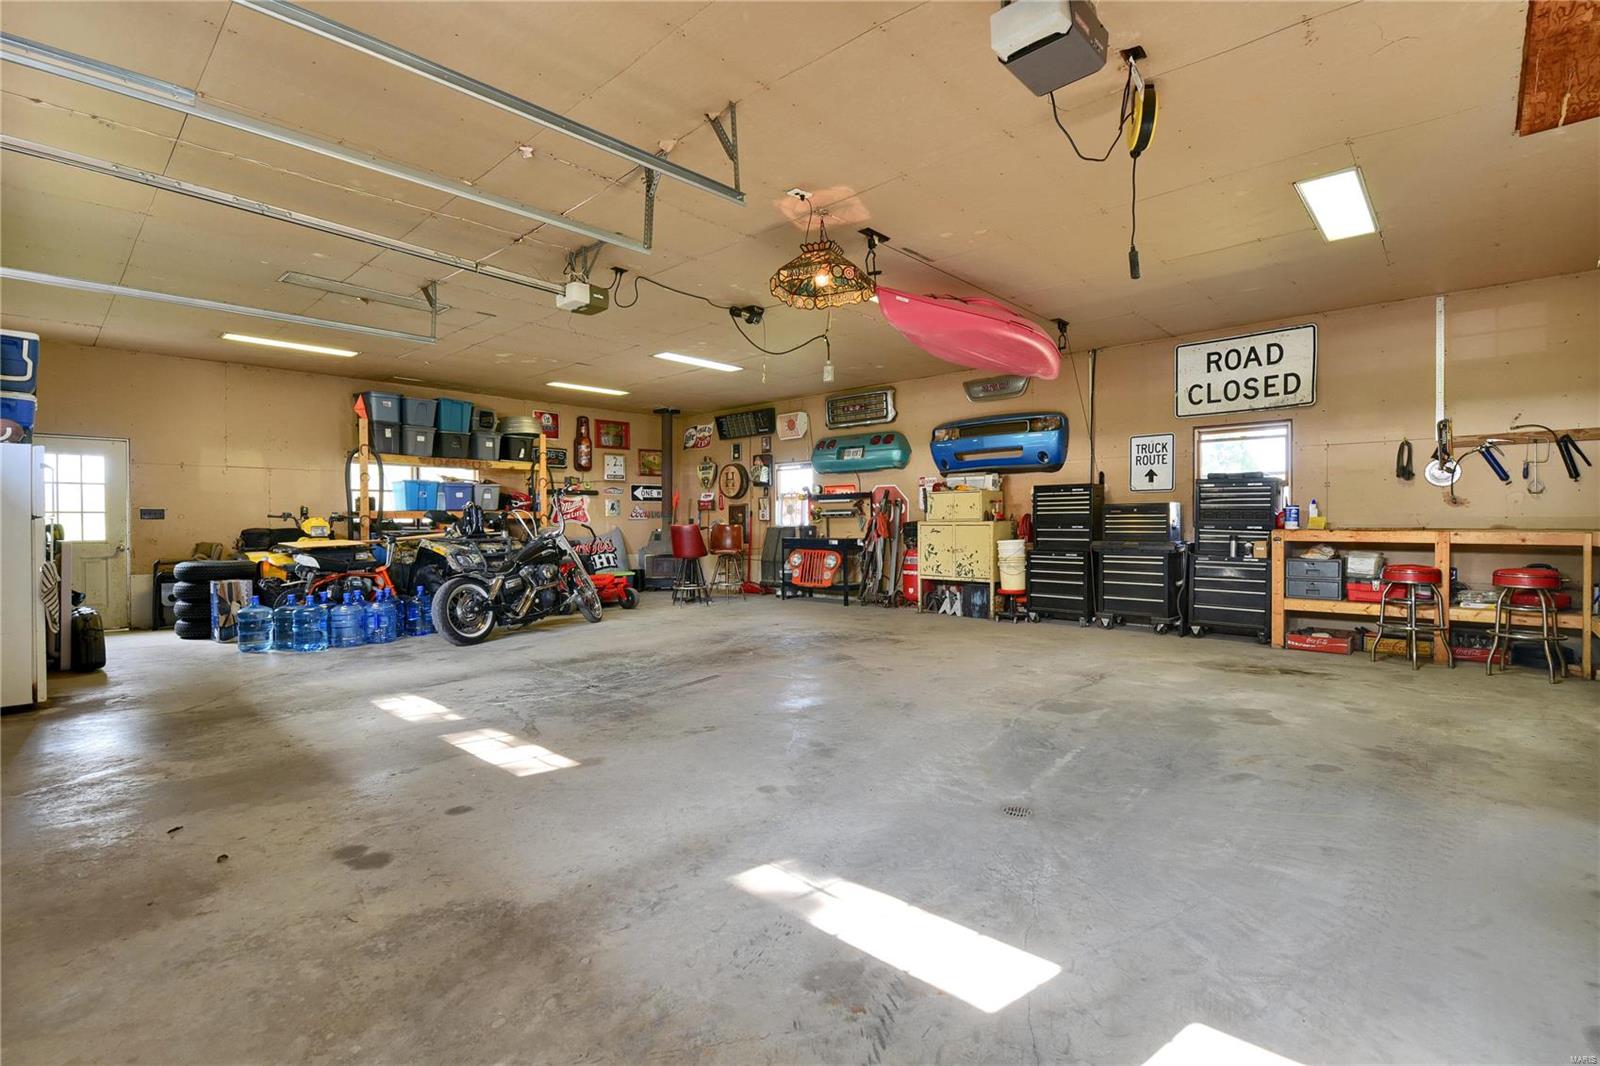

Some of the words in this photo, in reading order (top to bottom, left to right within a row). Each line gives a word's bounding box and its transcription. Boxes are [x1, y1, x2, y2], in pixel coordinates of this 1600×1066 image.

[1206, 342, 1284, 373] ROAD
[1187, 372, 1301, 405] CLOSED
[1136, 442, 1168, 455] TRUCK
[1135, 454, 1168, 466] ROUTE
[641, 489, 654, 497] ONE
